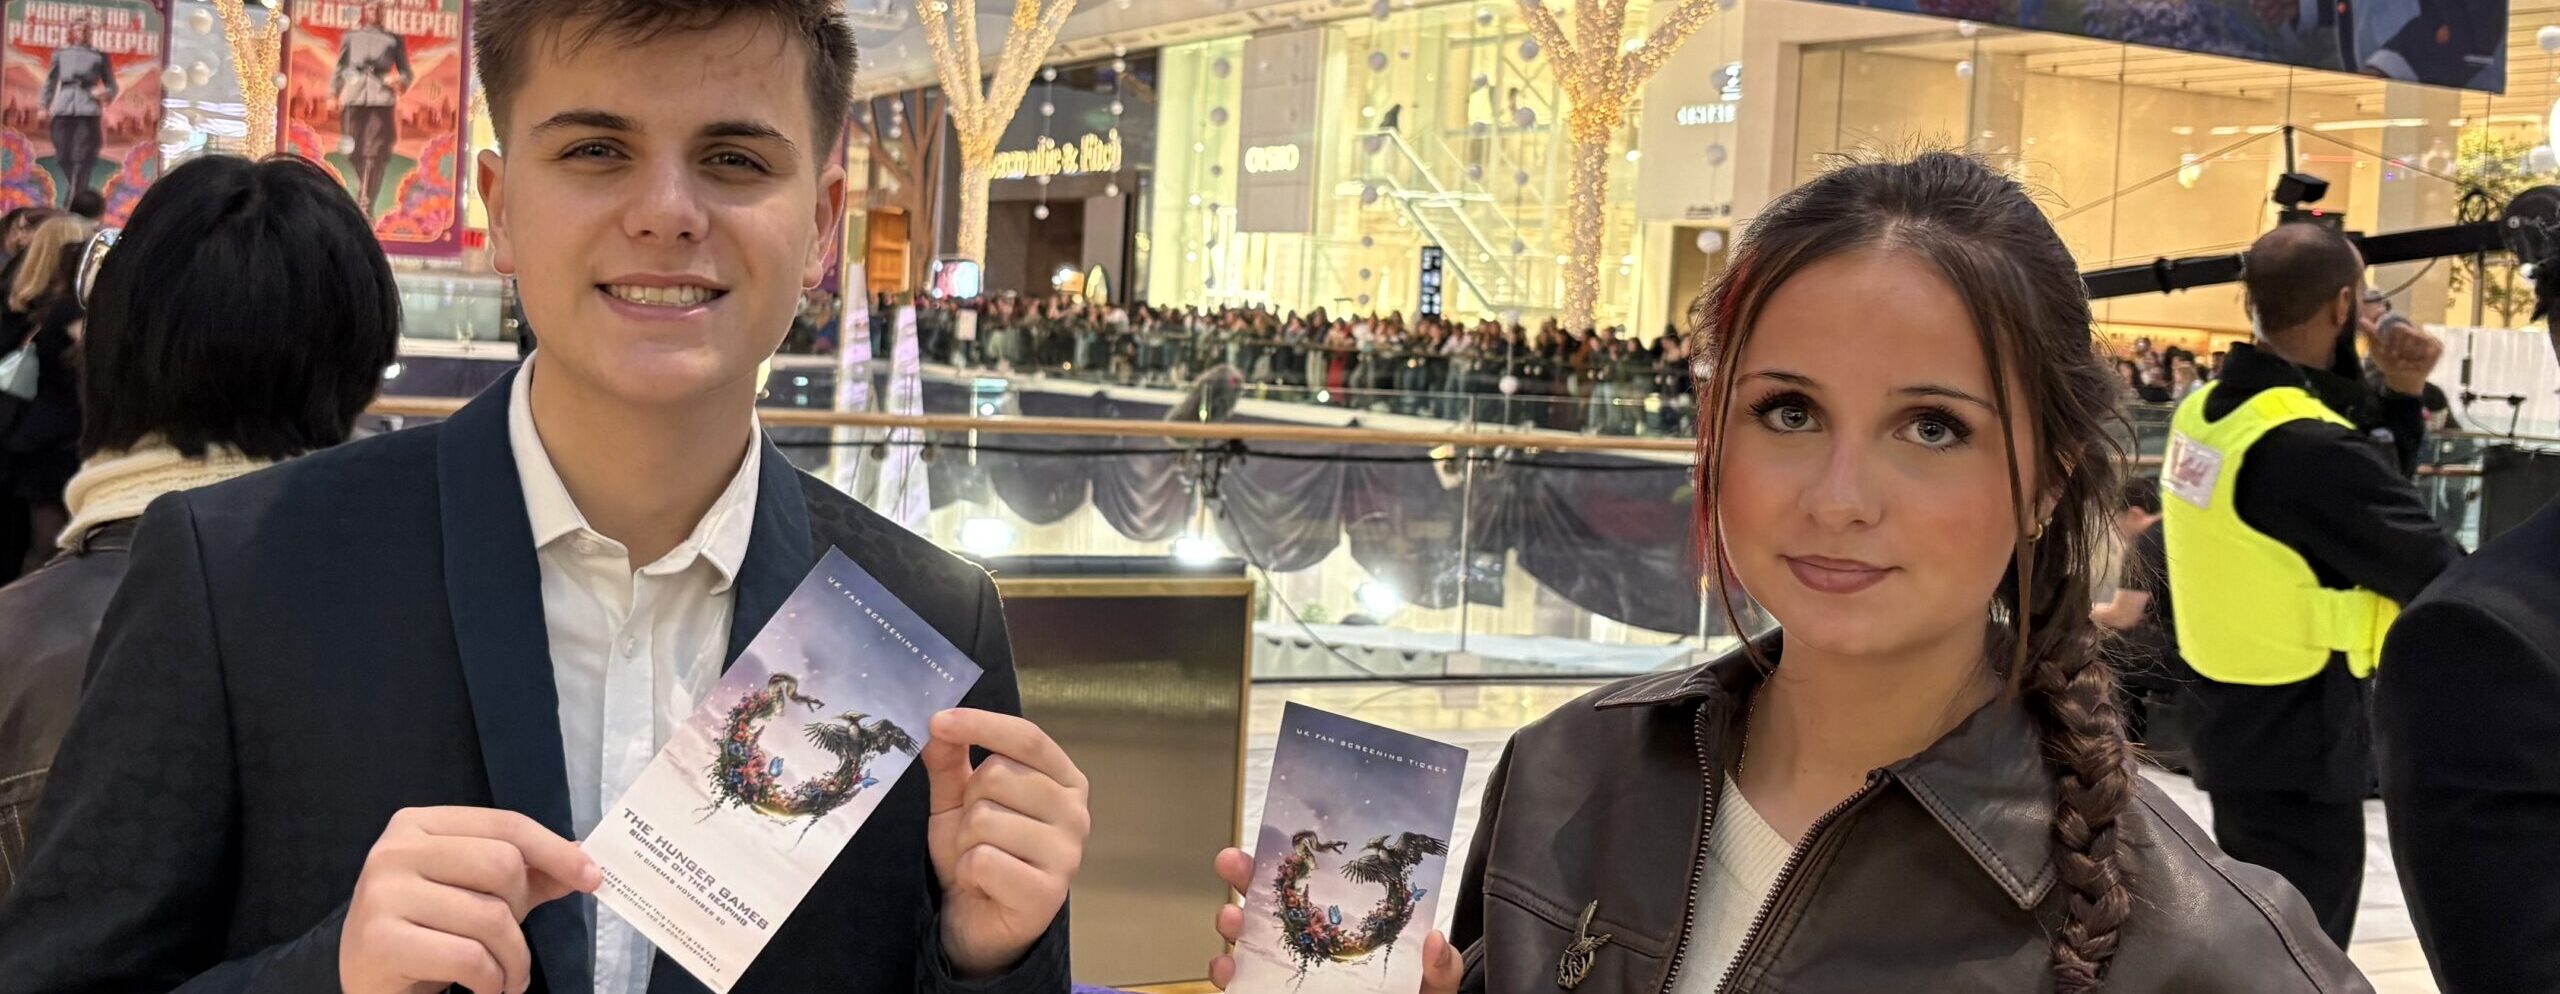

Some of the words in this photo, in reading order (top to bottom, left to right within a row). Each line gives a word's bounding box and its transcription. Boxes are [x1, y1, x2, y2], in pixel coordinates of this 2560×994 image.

[828, 576, 842, 589] UK
[865, 607, 920, 653] SCREENING
[922, 654, 955, 683] TICKET
[1296, 728, 1310, 737] UK
[1315, 732, 1335, 743] FAN
[1340, 740, 1403, 762] SCREENING
[1409, 758, 1448, 774] TICKET
[624, 807, 654, 836] THE
[655, 835, 716, 887] HUNGER
[718, 886, 769, 930] GAMES
[629, 828, 671, 863] SUNRISE
[671, 862, 686, 877] ON
[687, 875, 707, 893] THE
[707, 891, 749, 926] REAPING
[634, 849, 644, 859] IN
[644, 857, 676, 885] CINEMAS
[675, 884, 715, 916] NOVEMBER
